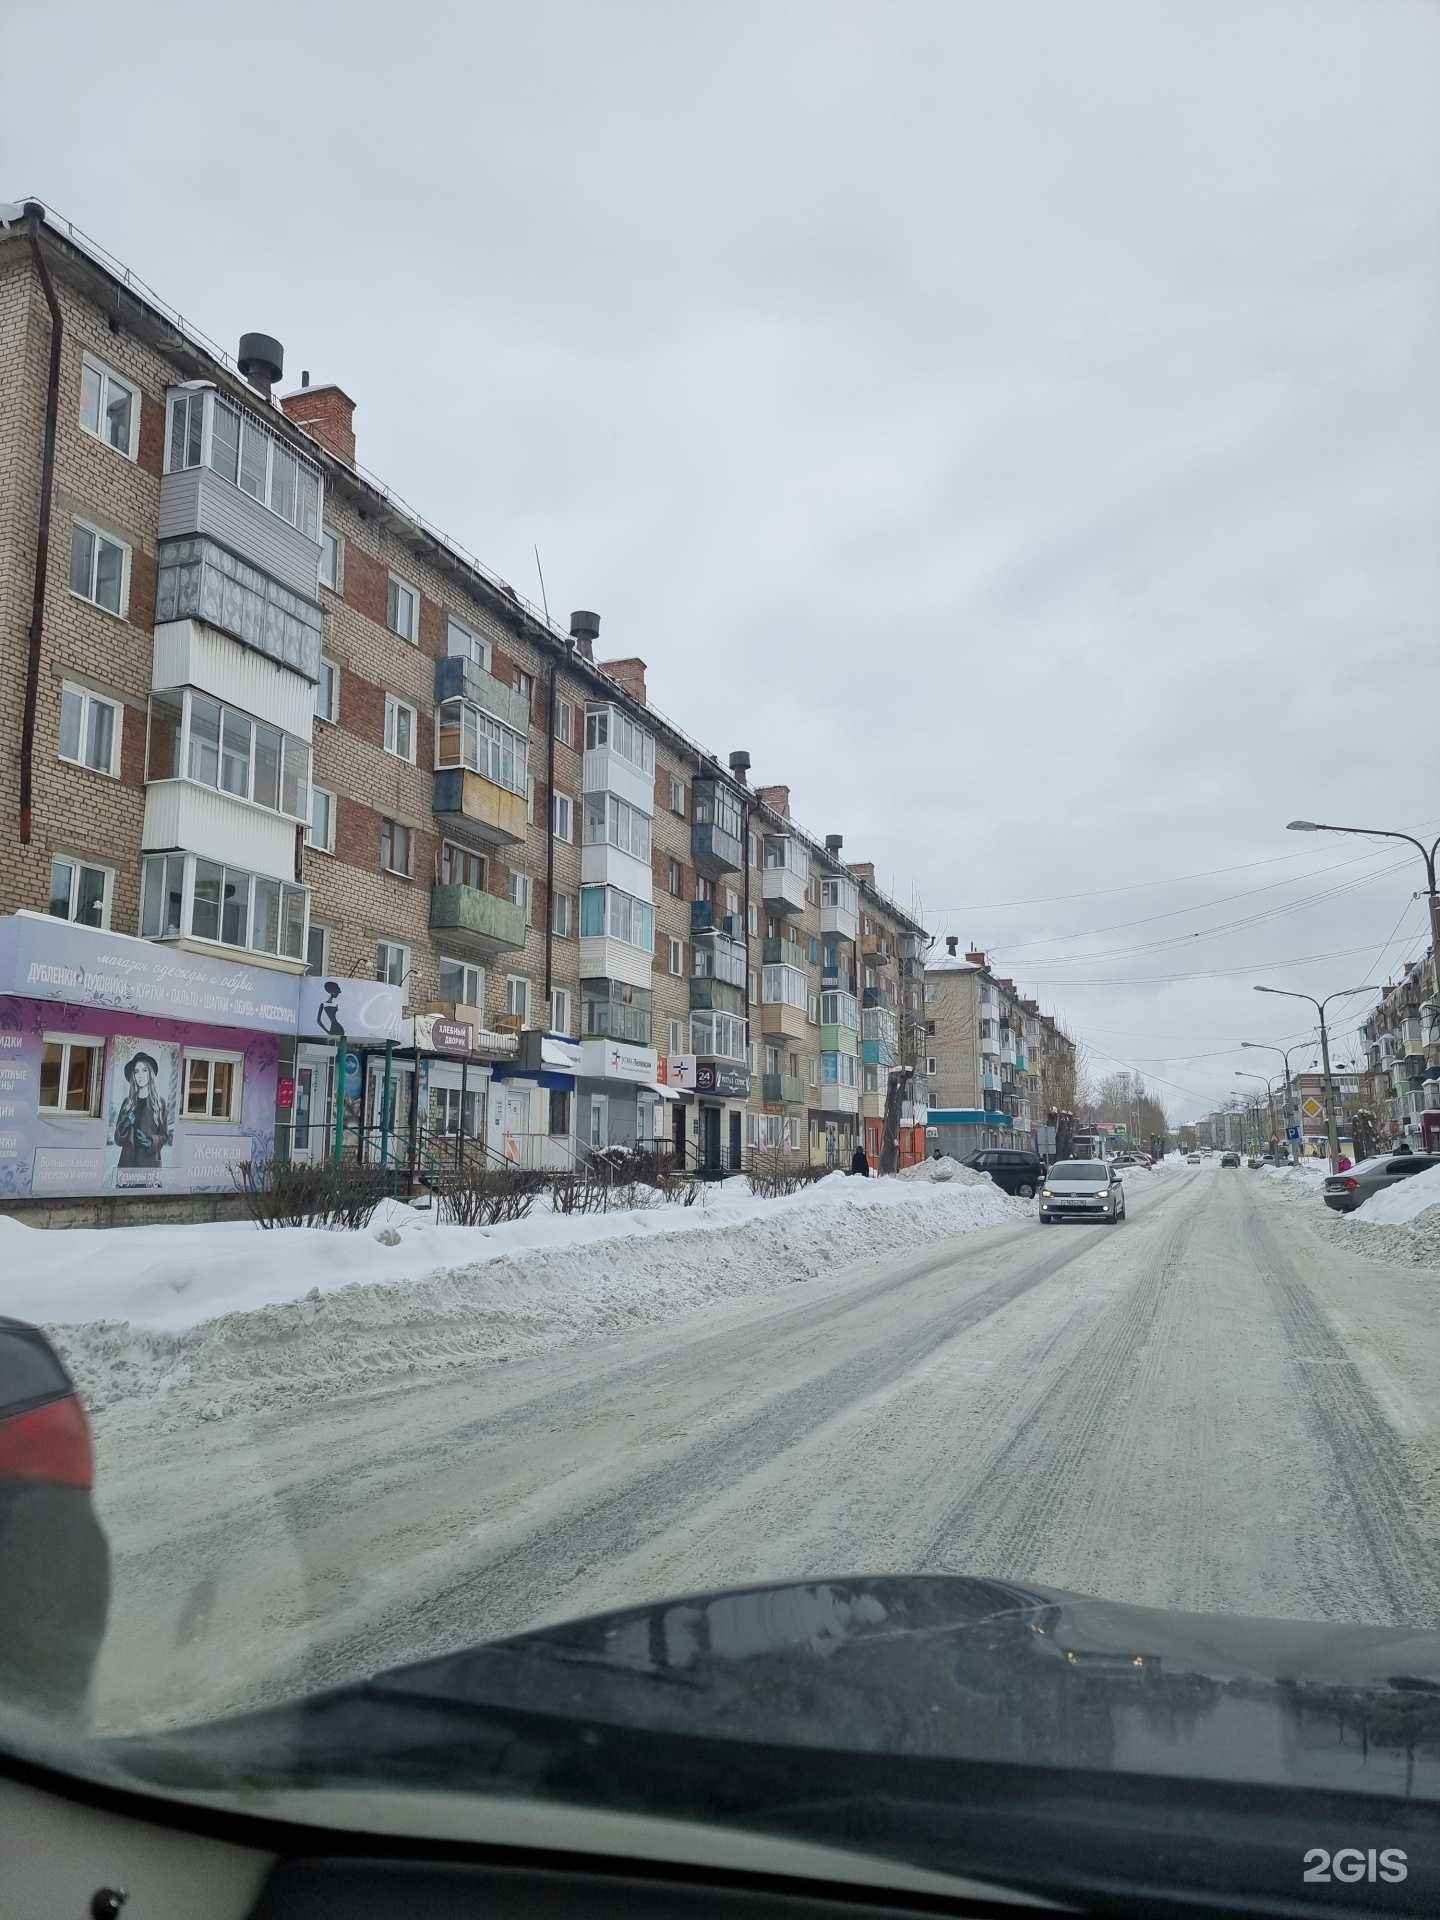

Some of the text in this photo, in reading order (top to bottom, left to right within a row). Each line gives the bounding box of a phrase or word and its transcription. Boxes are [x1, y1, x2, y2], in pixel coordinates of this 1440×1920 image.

[439, 1024, 466, 1038] ХЛЕБНЫЙ
[444, 1035, 466, 1048] ДВОРИК
[698, 1071, 710, 1081] 24
